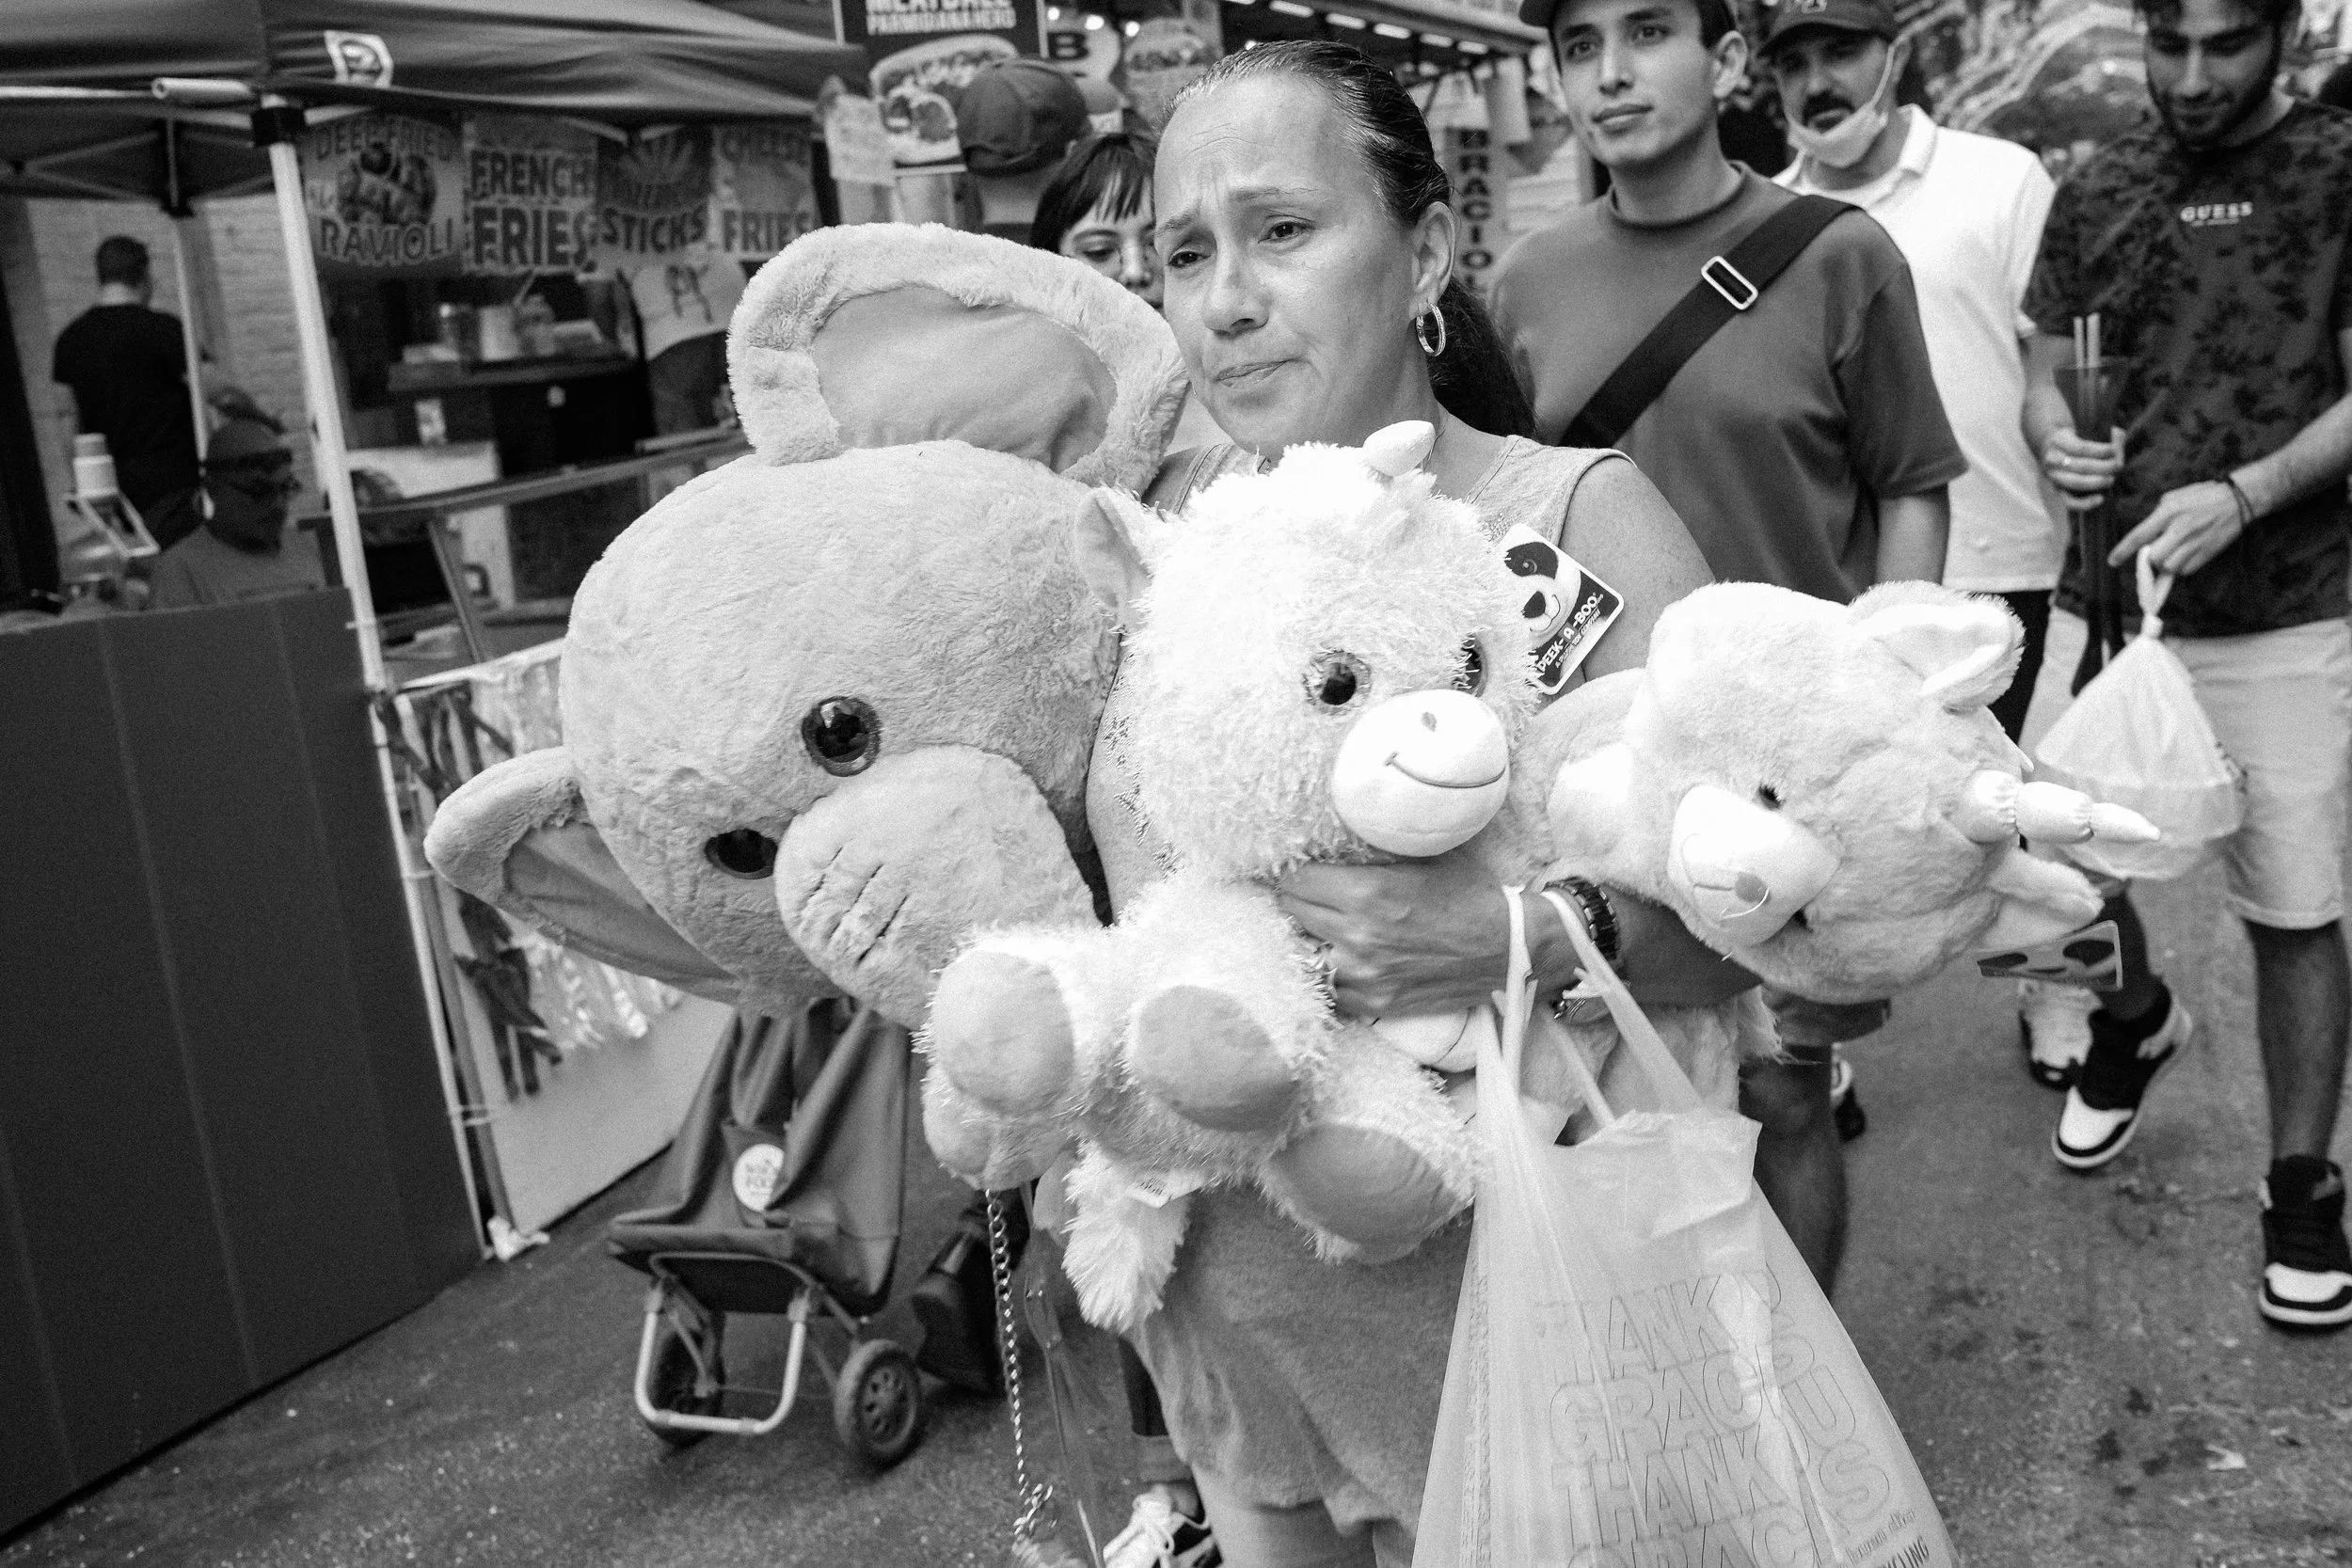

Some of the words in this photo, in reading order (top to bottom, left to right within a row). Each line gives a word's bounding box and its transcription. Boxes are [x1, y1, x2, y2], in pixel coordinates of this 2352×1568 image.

[471, 150, 591, 197] FRENCH
[321, 217, 454, 261] RAVIOLI
[473, 207, 587, 267] FRIES
[603, 203, 707, 252] STICKS
